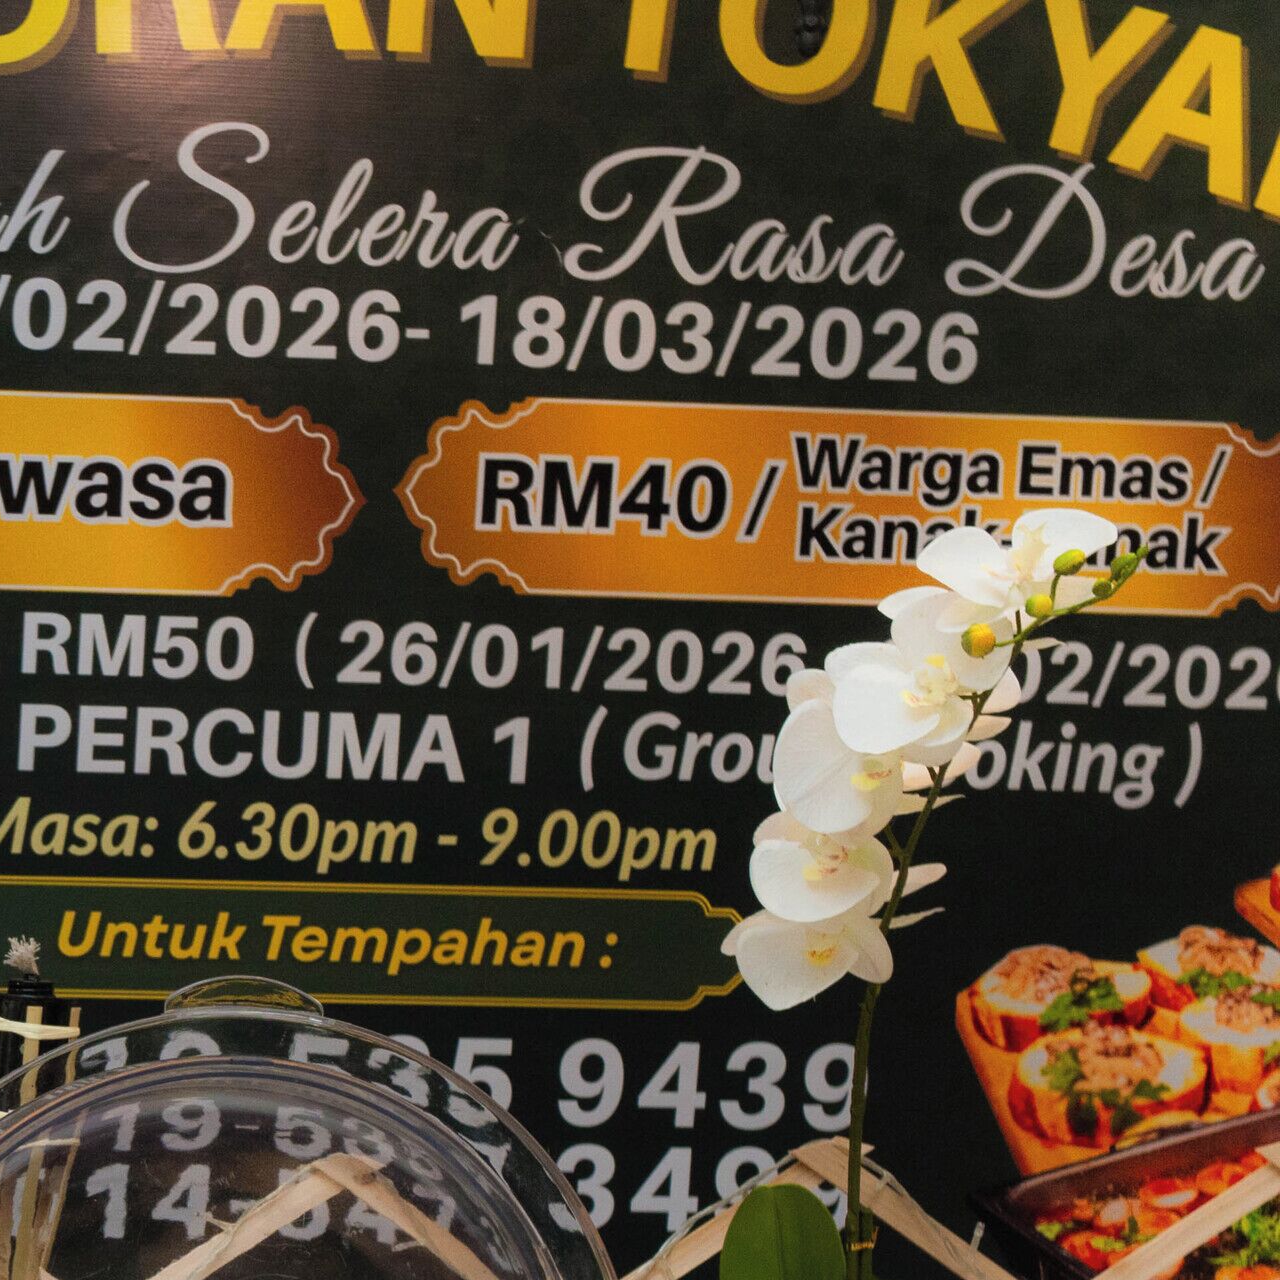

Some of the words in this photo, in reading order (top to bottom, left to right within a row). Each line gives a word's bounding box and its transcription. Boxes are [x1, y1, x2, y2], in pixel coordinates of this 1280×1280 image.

[622, 0, 1280, 222] TOKYA
[112, 122, 520, 275] Selera
[562, 145, 906, 286] Rasa
[944, 162, 1268, 301] Desa
[460, 294, 979, 384] 18/03/2026
[476, 452, 731, 539] RM40
[792, 433, 1001, 508] Warga
[1016, 440, 1191, 501] Emas
[21, 612, 255, 680] RM50
[17, 703, 465, 783] PERCUMA
[494, 717, 531, 784] 1
[623, 711, 775, 783] Gro
[963, 720, 1165, 810] oking
[178, 802, 419, 876] 6.30pm
[479, 810, 717, 880] 9.00pm
[58, 910, 243, 962] Untuk
[261, 914, 587, 974] Tempahan
[558, 1037, 868, 1132] 9439
